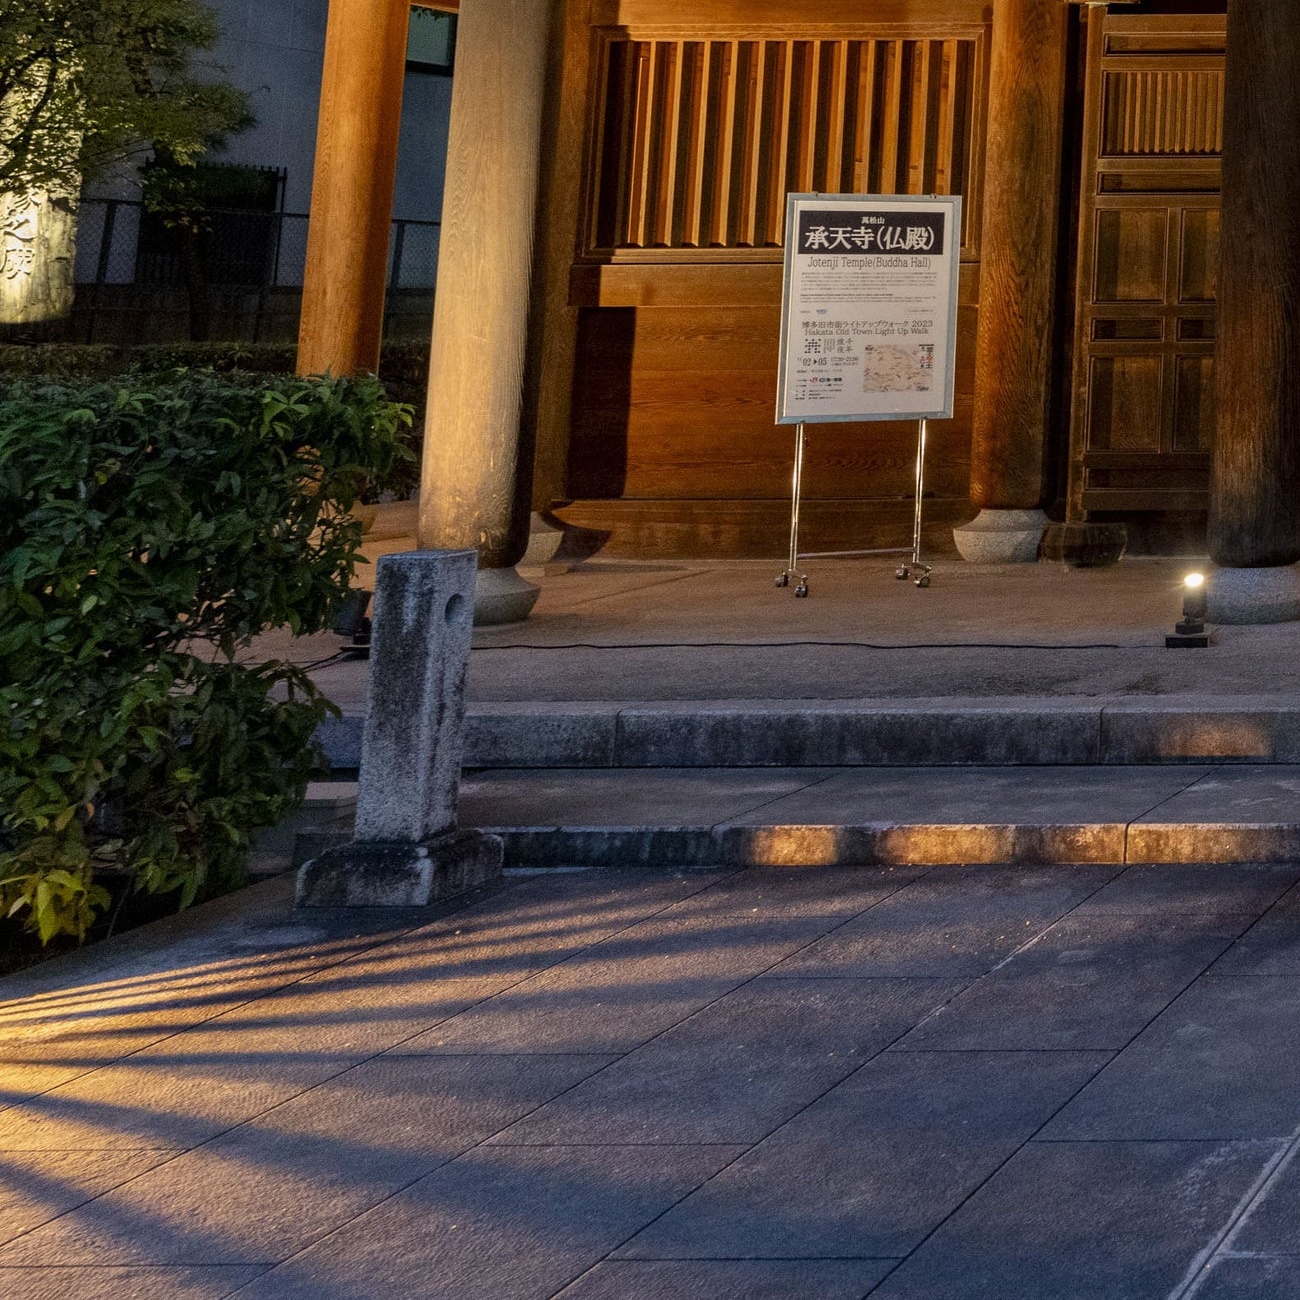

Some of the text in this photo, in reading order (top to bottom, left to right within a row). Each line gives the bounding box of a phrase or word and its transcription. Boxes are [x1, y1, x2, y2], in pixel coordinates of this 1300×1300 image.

[807, 256, 838, 270] Jotenji
[911, 319, 933, 328] 2023
[804, 328, 833, 336] Hakata
[835, 328, 850, 336] Old
